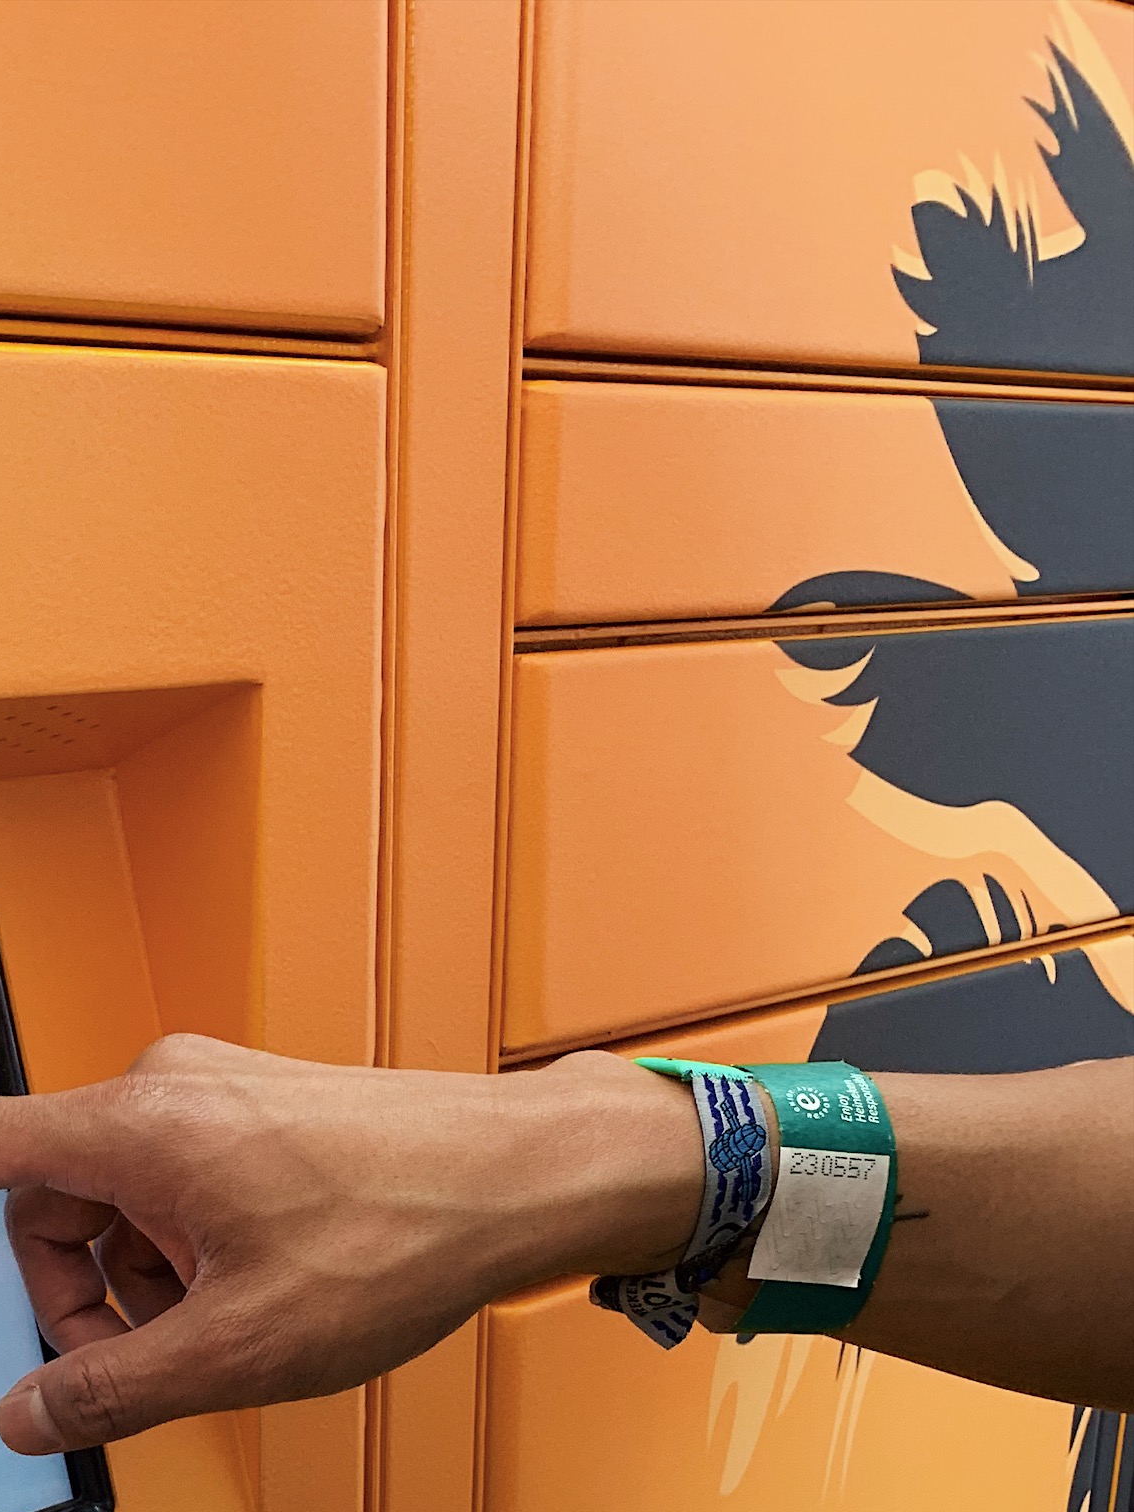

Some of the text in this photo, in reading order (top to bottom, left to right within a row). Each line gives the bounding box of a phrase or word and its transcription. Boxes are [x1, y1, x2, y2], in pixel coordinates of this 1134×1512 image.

[837, 1093, 853, 1122] Enjoy
[844, 1079, 867, 1123] Heineken
[850, 1073, 880, 1124] Responsibly
[790, 1152, 876, 1180] 230557
